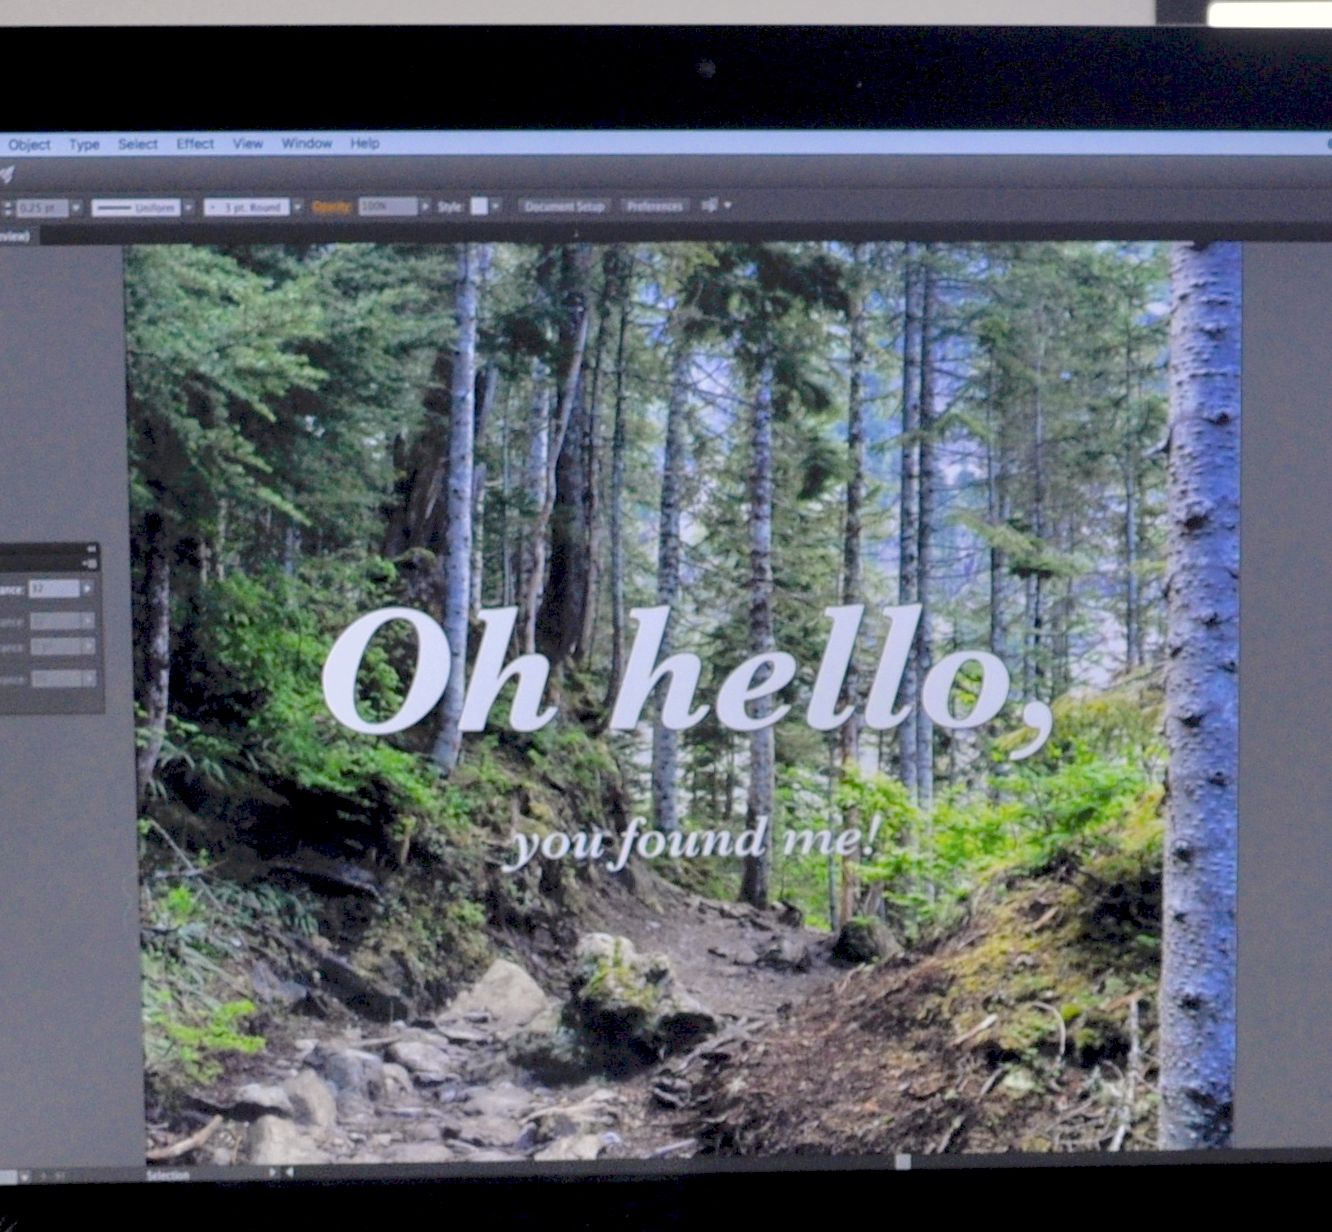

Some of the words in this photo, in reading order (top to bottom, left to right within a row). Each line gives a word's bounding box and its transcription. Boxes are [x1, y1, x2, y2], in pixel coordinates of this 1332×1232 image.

[9, 139, 51, 152] Object
[70, 139, 100, 153] Type
[118, 138, 158, 150] Select
[177, 138, 214, 150] Effect
[233, 138, 263, 149] View
[282, 138, 333, 149] Window
[351, 138, 380, 151] Help
[524, 201, 573, 212] Document
[576, 201, 606, 215] Setup
[627, 201, 683, 213] Preferences
[321, 605, 558, 735] Oh
[609, 603, 1054, 761] hello,
[502, 827, 603, 872] you
[606, 816, 766, 872] found
[784, 814, 881, 858] me!
[146, 1169, 191, 1181] Selection
